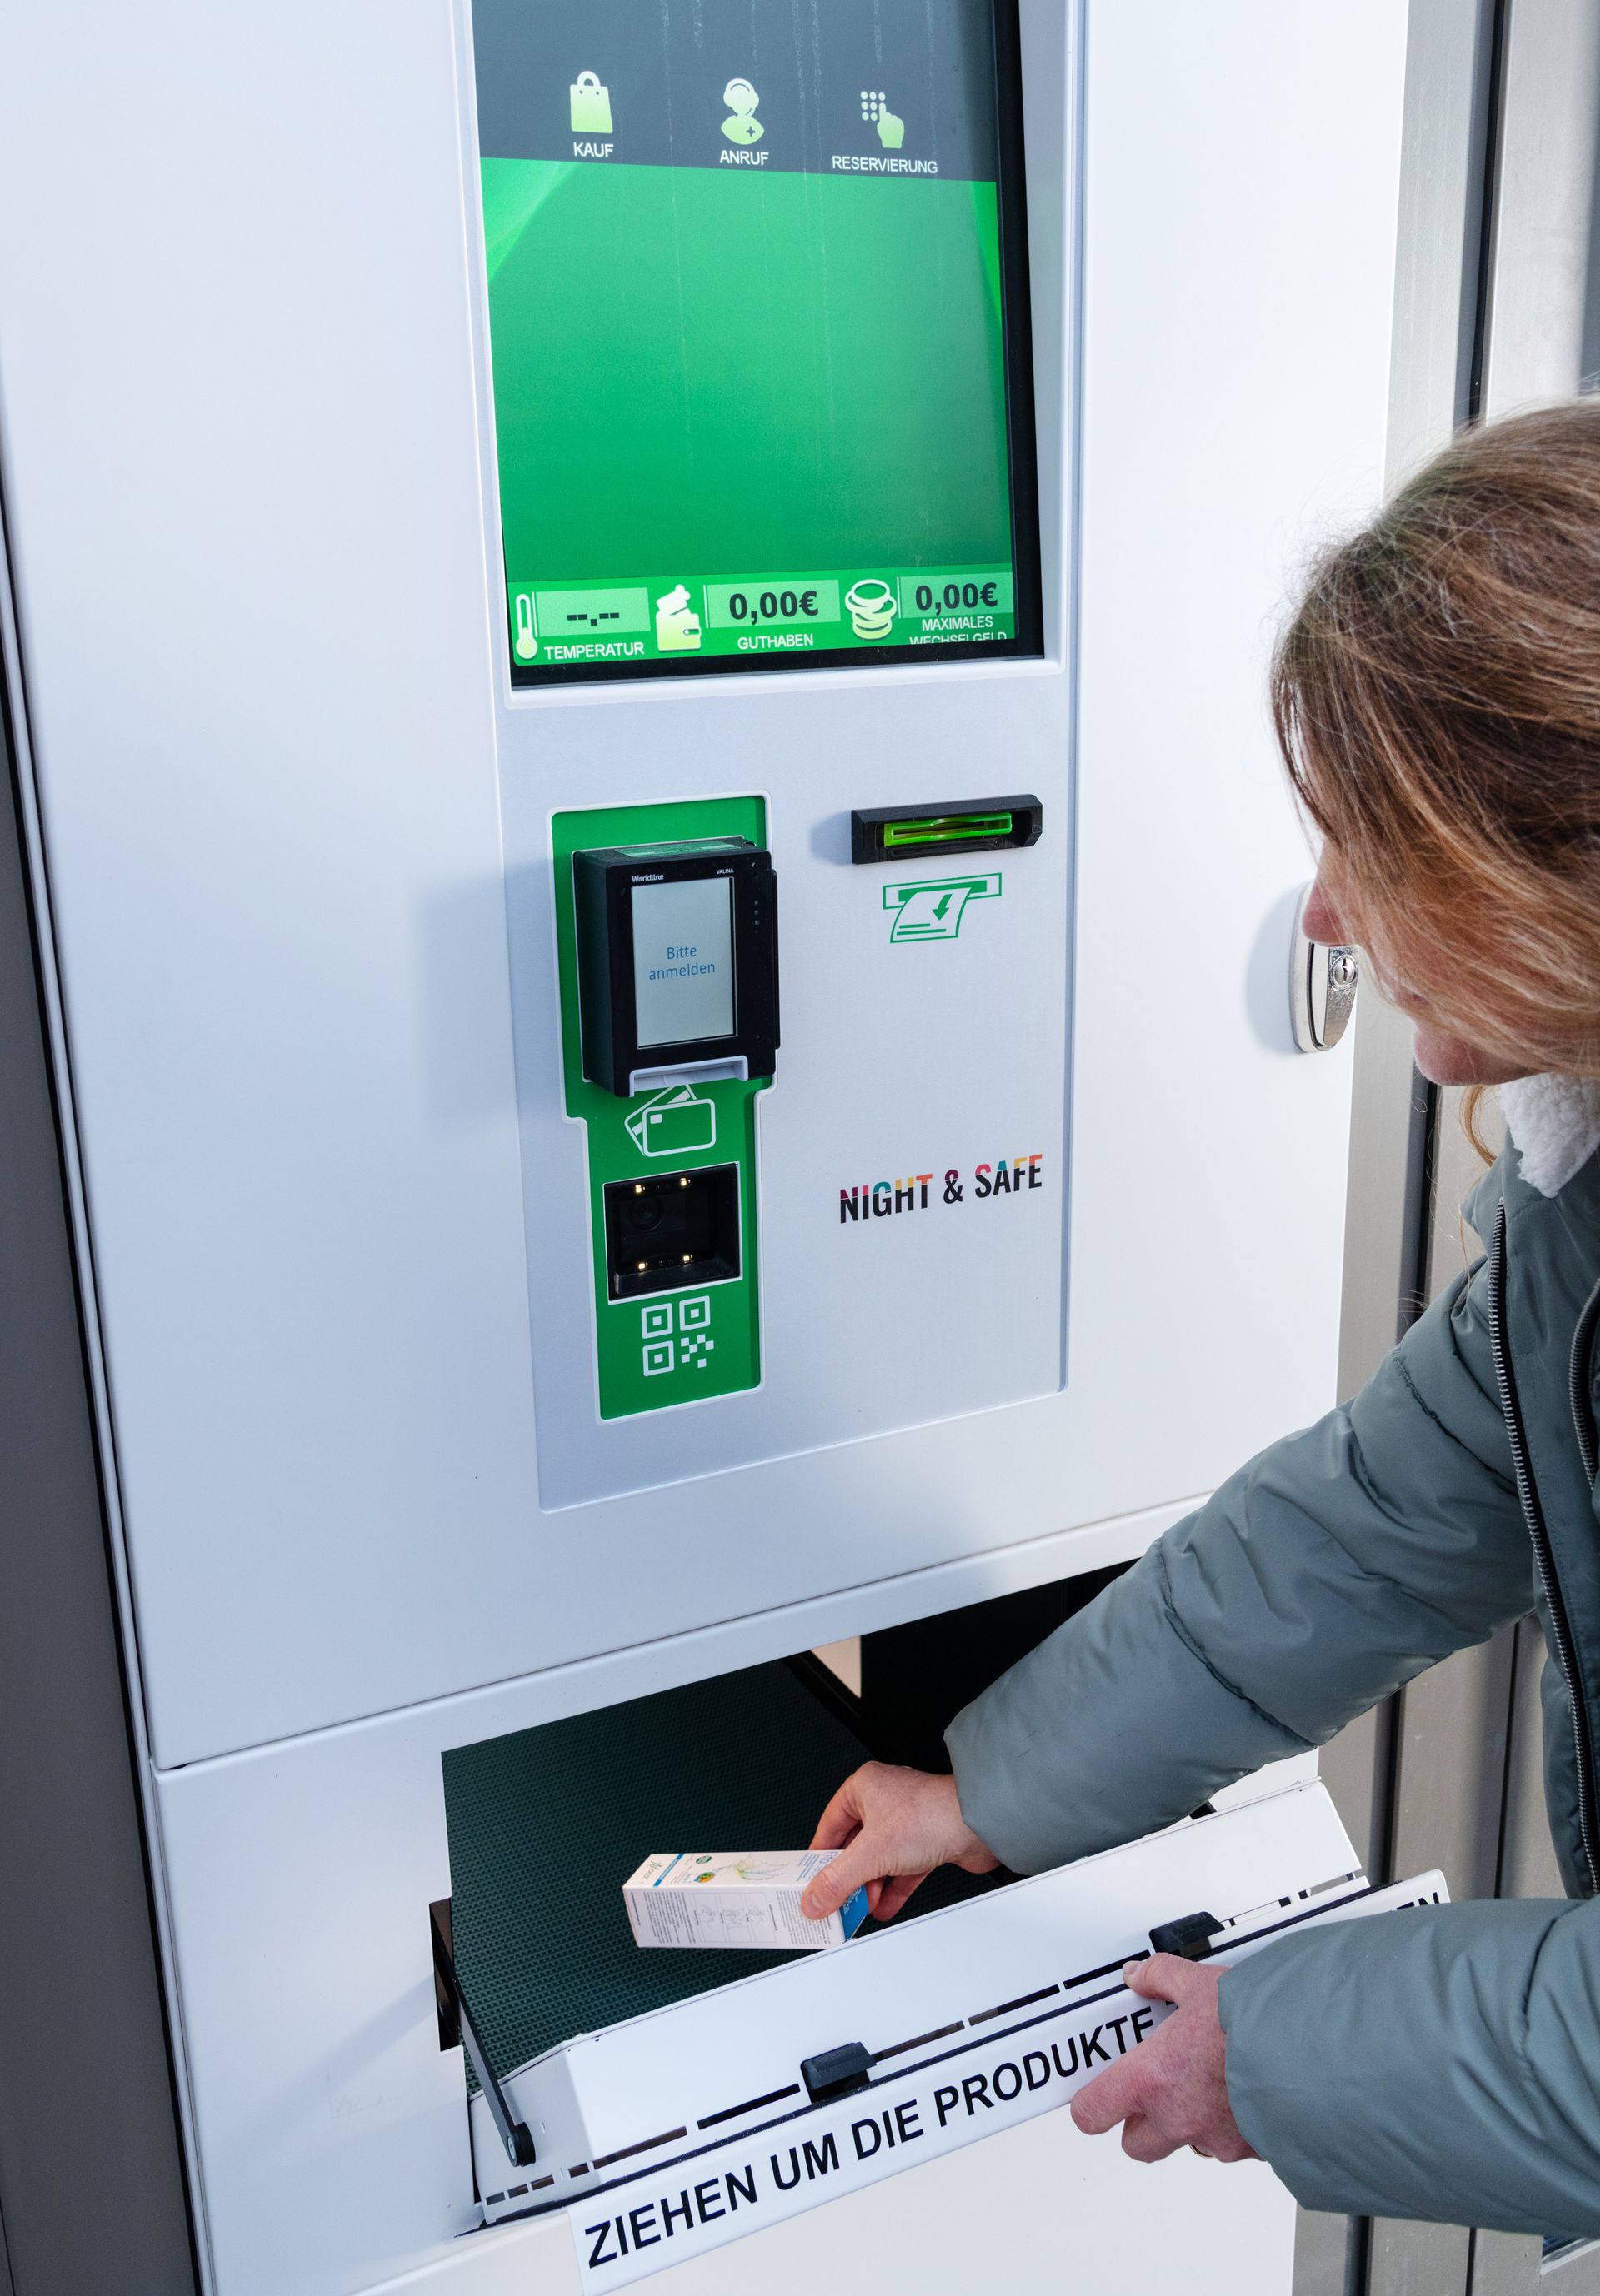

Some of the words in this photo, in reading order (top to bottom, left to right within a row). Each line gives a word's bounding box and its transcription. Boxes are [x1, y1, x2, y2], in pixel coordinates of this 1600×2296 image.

[573, 142, 614, 158] KAUF
[719, 149, 769, 166] ANRUF
[832, 155, 938, 174] RESERVIERUNG
[729, 590, 819, 626] 0,00€
[915, 581, 998, 616] 0,00€
[922, 616, 993, 631] MAXIMALES
[543, 641, 645, 660] TEMPERATUR
[737, 633, 814, 650] GUTHABEN
[631, 873, 664, 883] Worldline
[666, 946, 698, 960] Bitte
[648, 962, 716, 981] anmelden
[839, 1173, 933, 1225] NIGHT
[942, 1169, 963, 1205] &
[974, 1153, 1042, 1199] SAFE
[584, 2164, 758, 2269] ZIEHEN
[769, 2132, 841, 2192] UM
[850, 2099, 925, 2161] DIE
